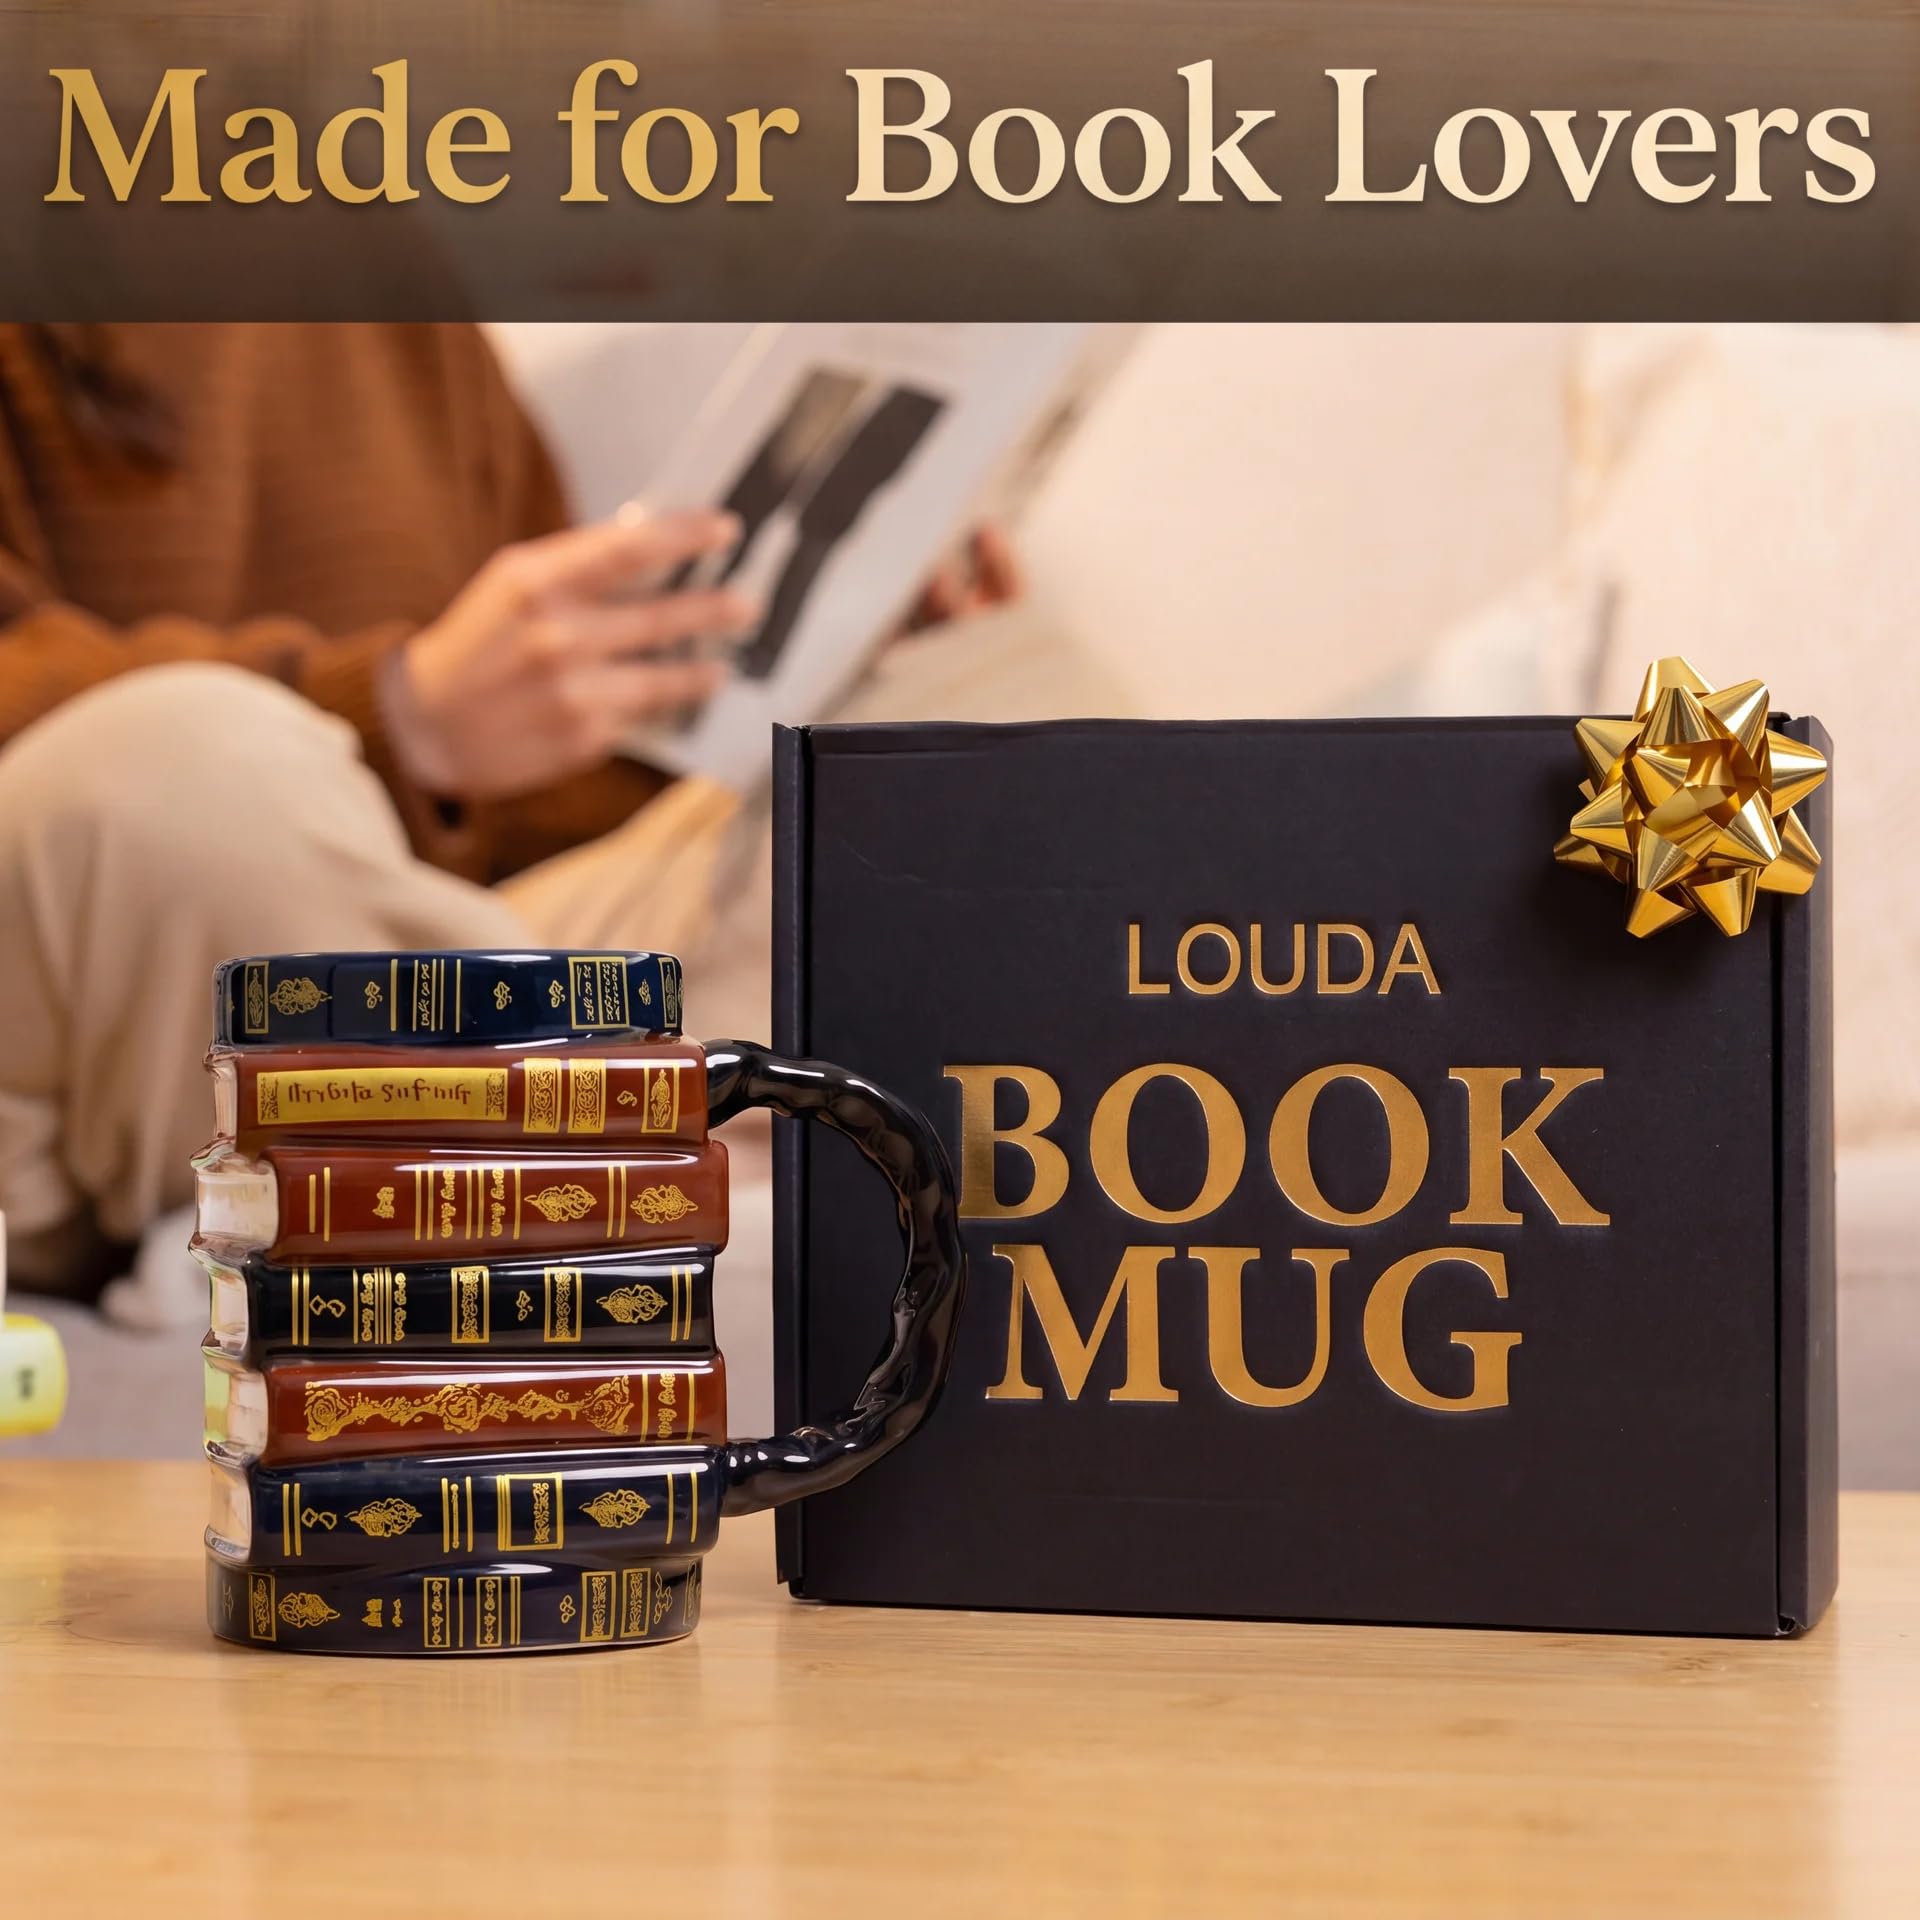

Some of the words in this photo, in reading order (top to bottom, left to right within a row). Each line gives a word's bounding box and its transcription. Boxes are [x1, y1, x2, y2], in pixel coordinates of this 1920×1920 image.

[1127, 922, 1442, 996] LOUDA
[943, 1062, 1612, 1227] BOOK
[985, 1244, 1523, 1413] MUG
